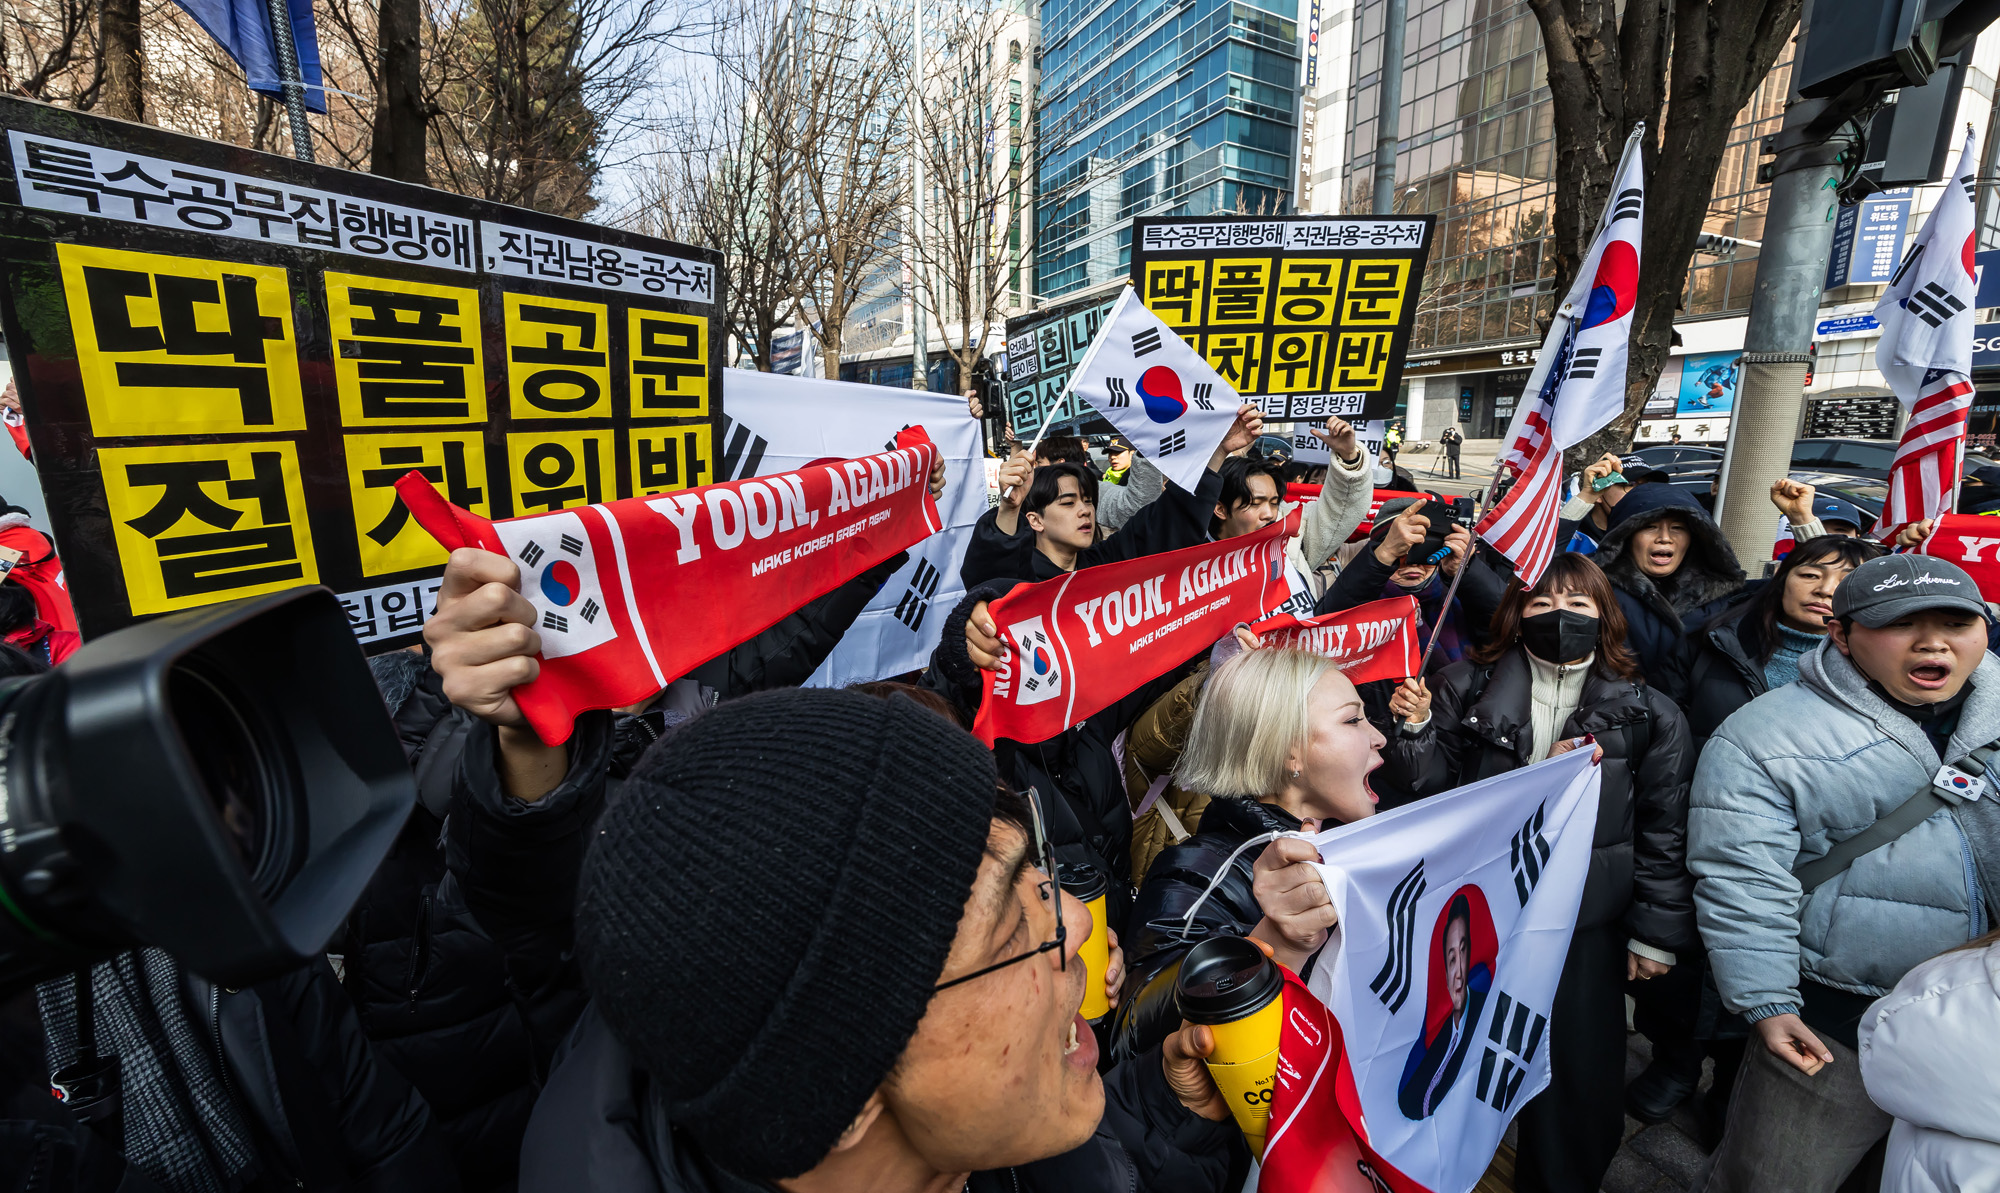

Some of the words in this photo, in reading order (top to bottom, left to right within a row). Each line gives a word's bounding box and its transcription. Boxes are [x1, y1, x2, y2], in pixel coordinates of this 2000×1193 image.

[1870, 212, 1899, 222] 위드유
[1009, 331, 1035, 357] 언제나
[1185, 334, 1389, 392] 차위반
[1011, 356, 1037, 377] 파이팅
[1292, 394, 1363, 416] 정당방위
[645, 473, 819, 566] YOON,
[751, 552, 793, 578] MAKE
[793, 533, 834, 558] KOREA
[835, 518, 867, 543] GREAT
[867, 507, 892, 533] AGAIN
[1913, 571, 1961, 585] Avenue
[1074, 573, 1172, 648] YOON,
[1129, 635, 1154, 655] MAKE
[1154, 620, 1184, 644] KOREA
[1184, 606, 1209, 631] GREAT
[1209, 594, 1231, 618] AGAIN
[992, 633, 1011, 699] OON
[1255, 1076, 1269, 1087] No.1
